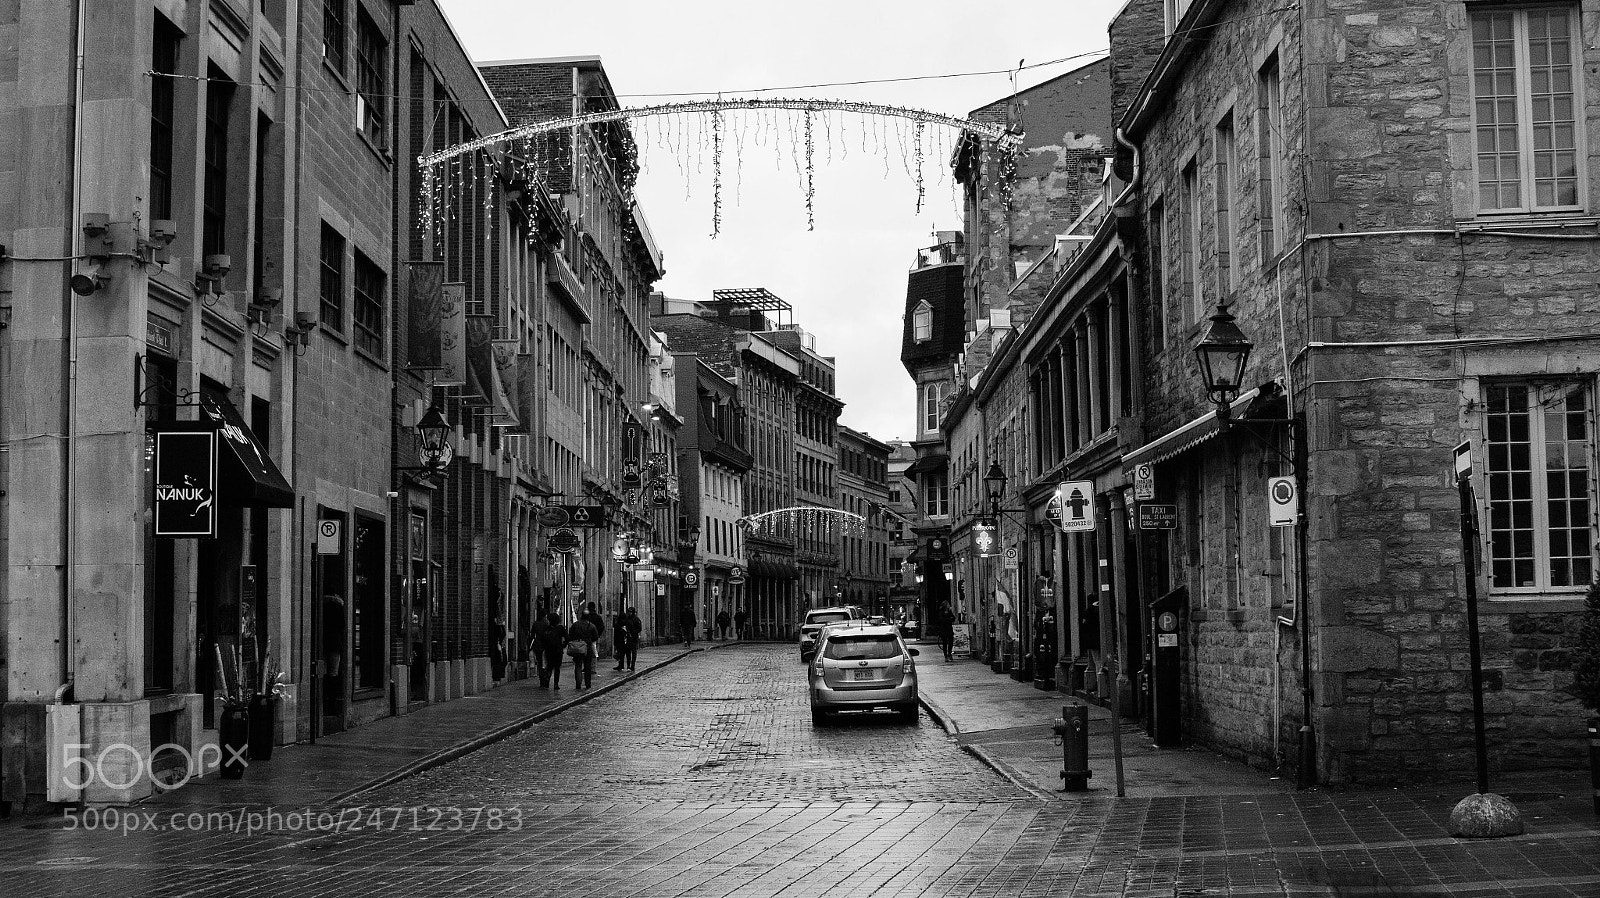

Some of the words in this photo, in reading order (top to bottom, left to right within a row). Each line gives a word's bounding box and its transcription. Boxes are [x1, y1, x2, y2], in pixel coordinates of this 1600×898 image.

[156, 488, 204, 501] NANUK
[1151, 506, 1166, 514] TAXI
[1163, 615, 1172, 629] P
